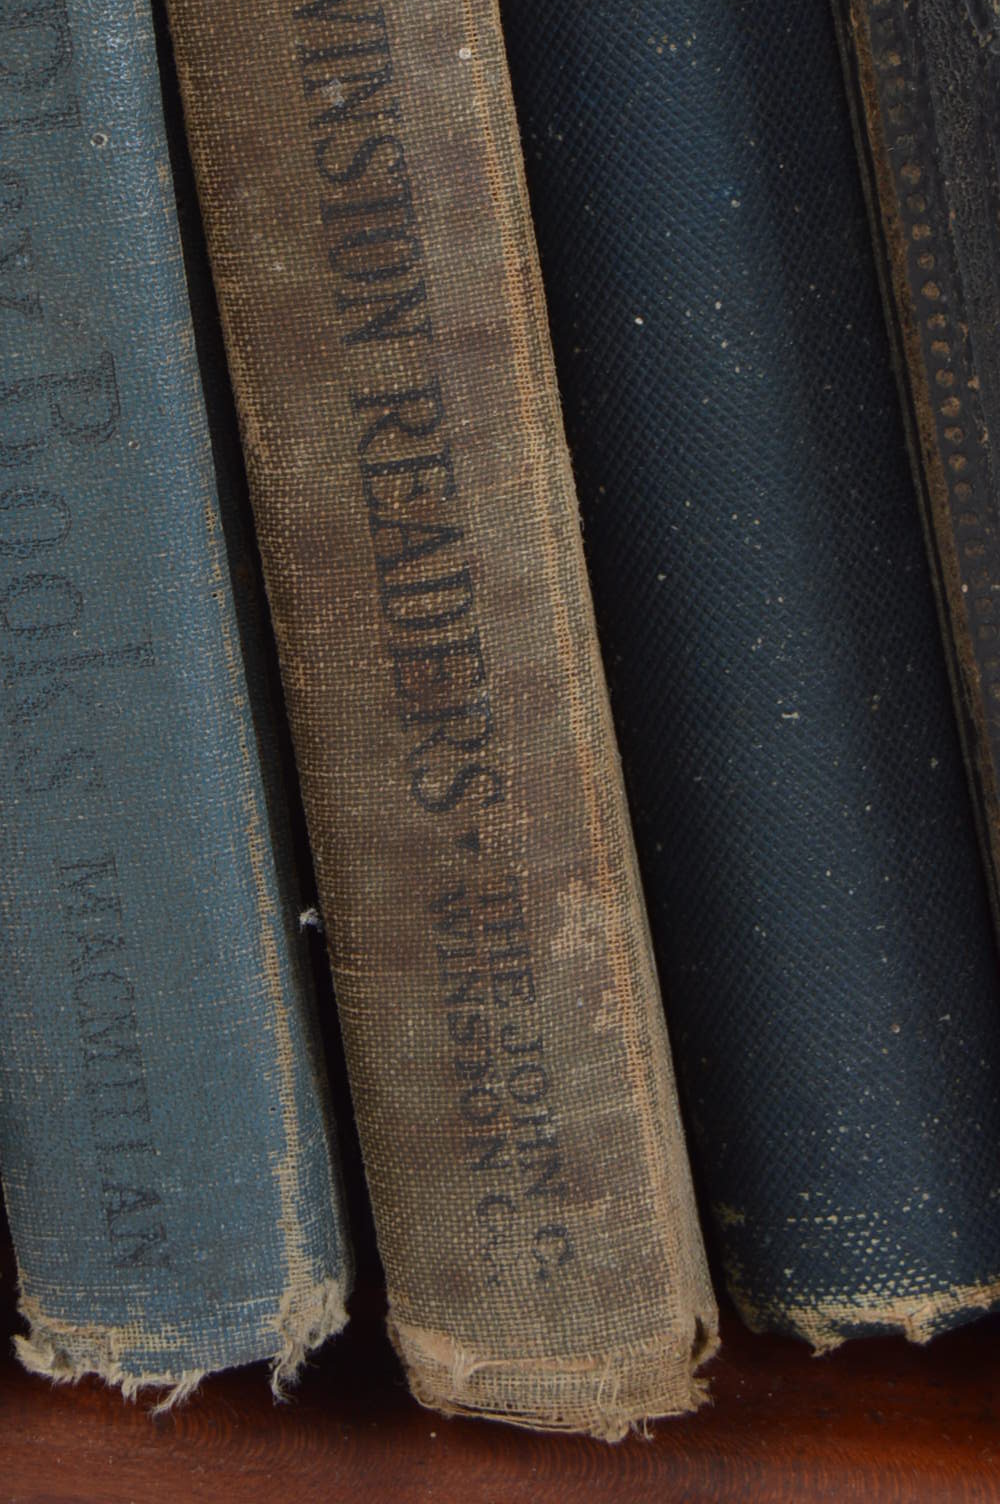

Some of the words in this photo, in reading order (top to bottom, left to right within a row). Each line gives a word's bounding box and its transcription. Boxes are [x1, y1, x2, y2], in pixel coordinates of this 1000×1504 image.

[355, 372, 504, 816] READERS
[58, 856, 170, 1274] MACMILLAN
[429, 880, 510, 1172] WINSTON
[478, 874, 536, 1008] THE
[499, 1022, 567, 1199] JOHN
